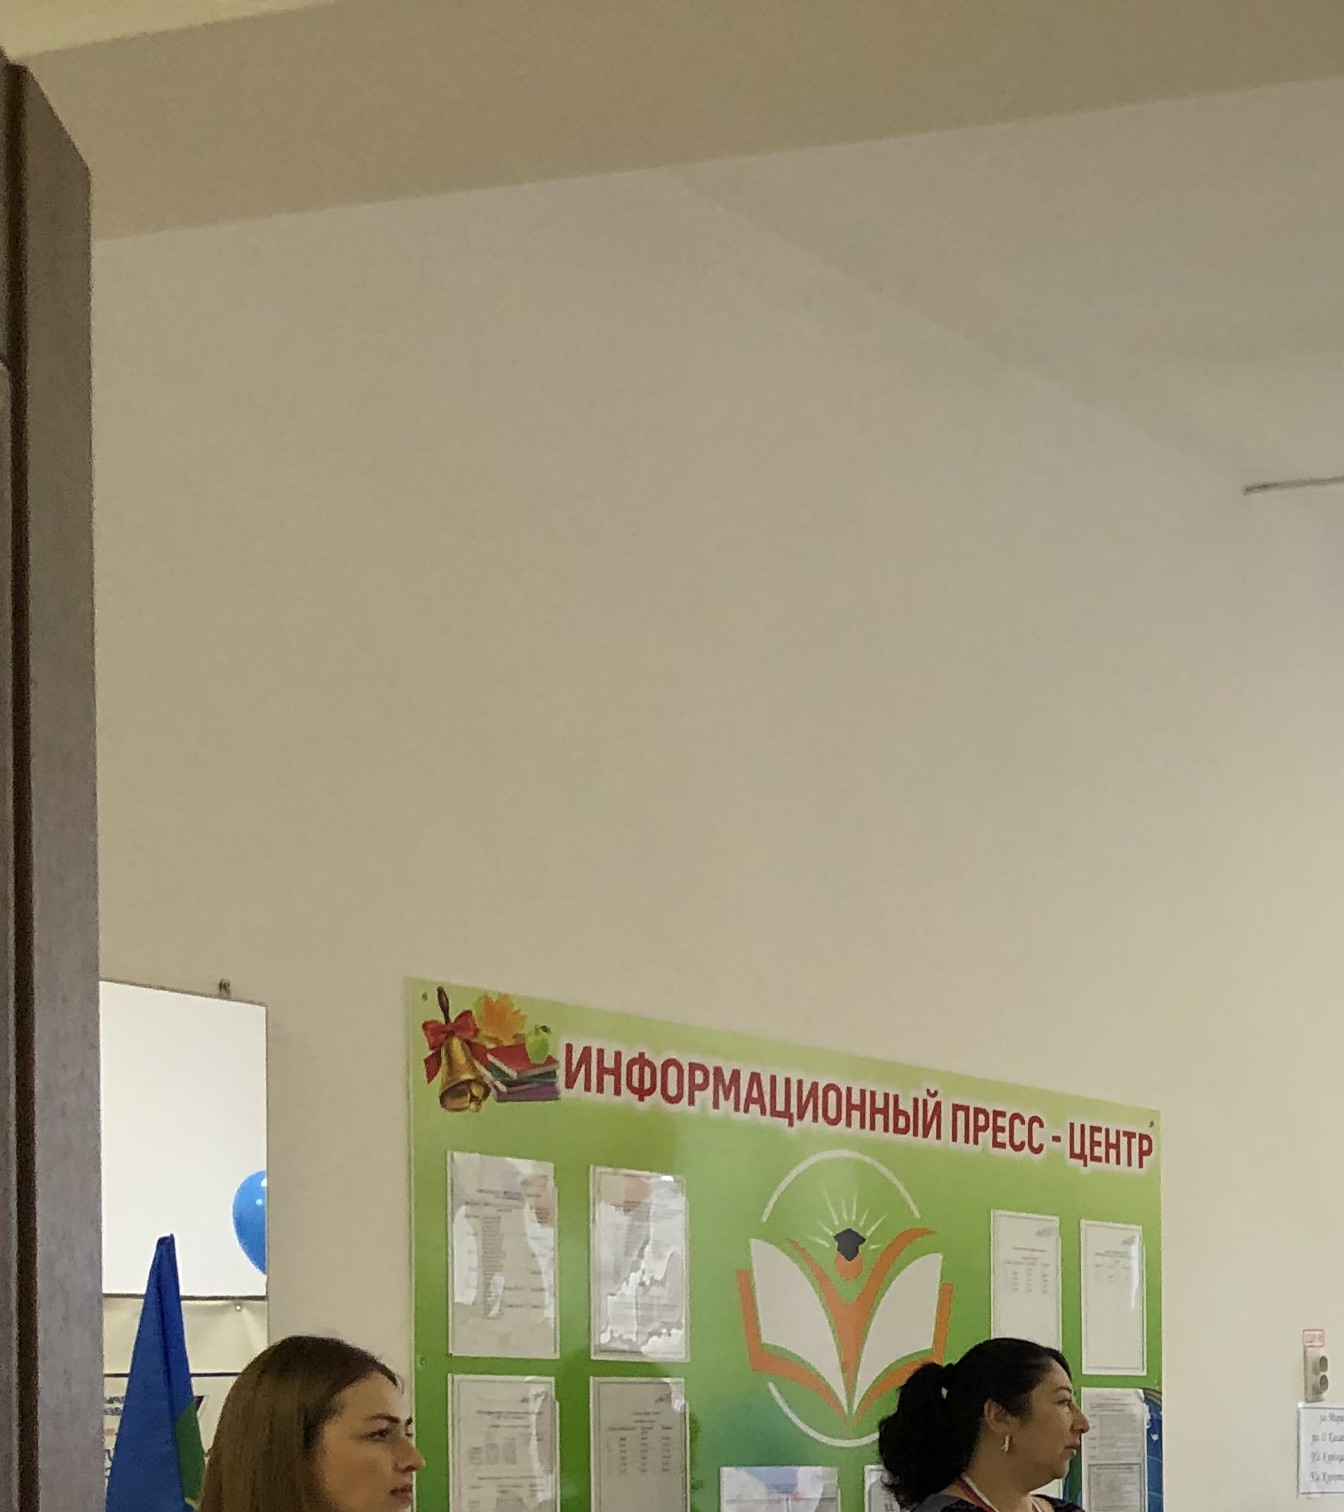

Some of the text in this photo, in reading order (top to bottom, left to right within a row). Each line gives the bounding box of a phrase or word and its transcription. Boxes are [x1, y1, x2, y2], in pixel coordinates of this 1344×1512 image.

[564, 1042, 943, 1141] ИНФОРМАЦИОННЫЙ
[951, 1103, 1045, 1155] ПРЕСС
[1068, 1121, 1154, 1169] ЦЕНТР
